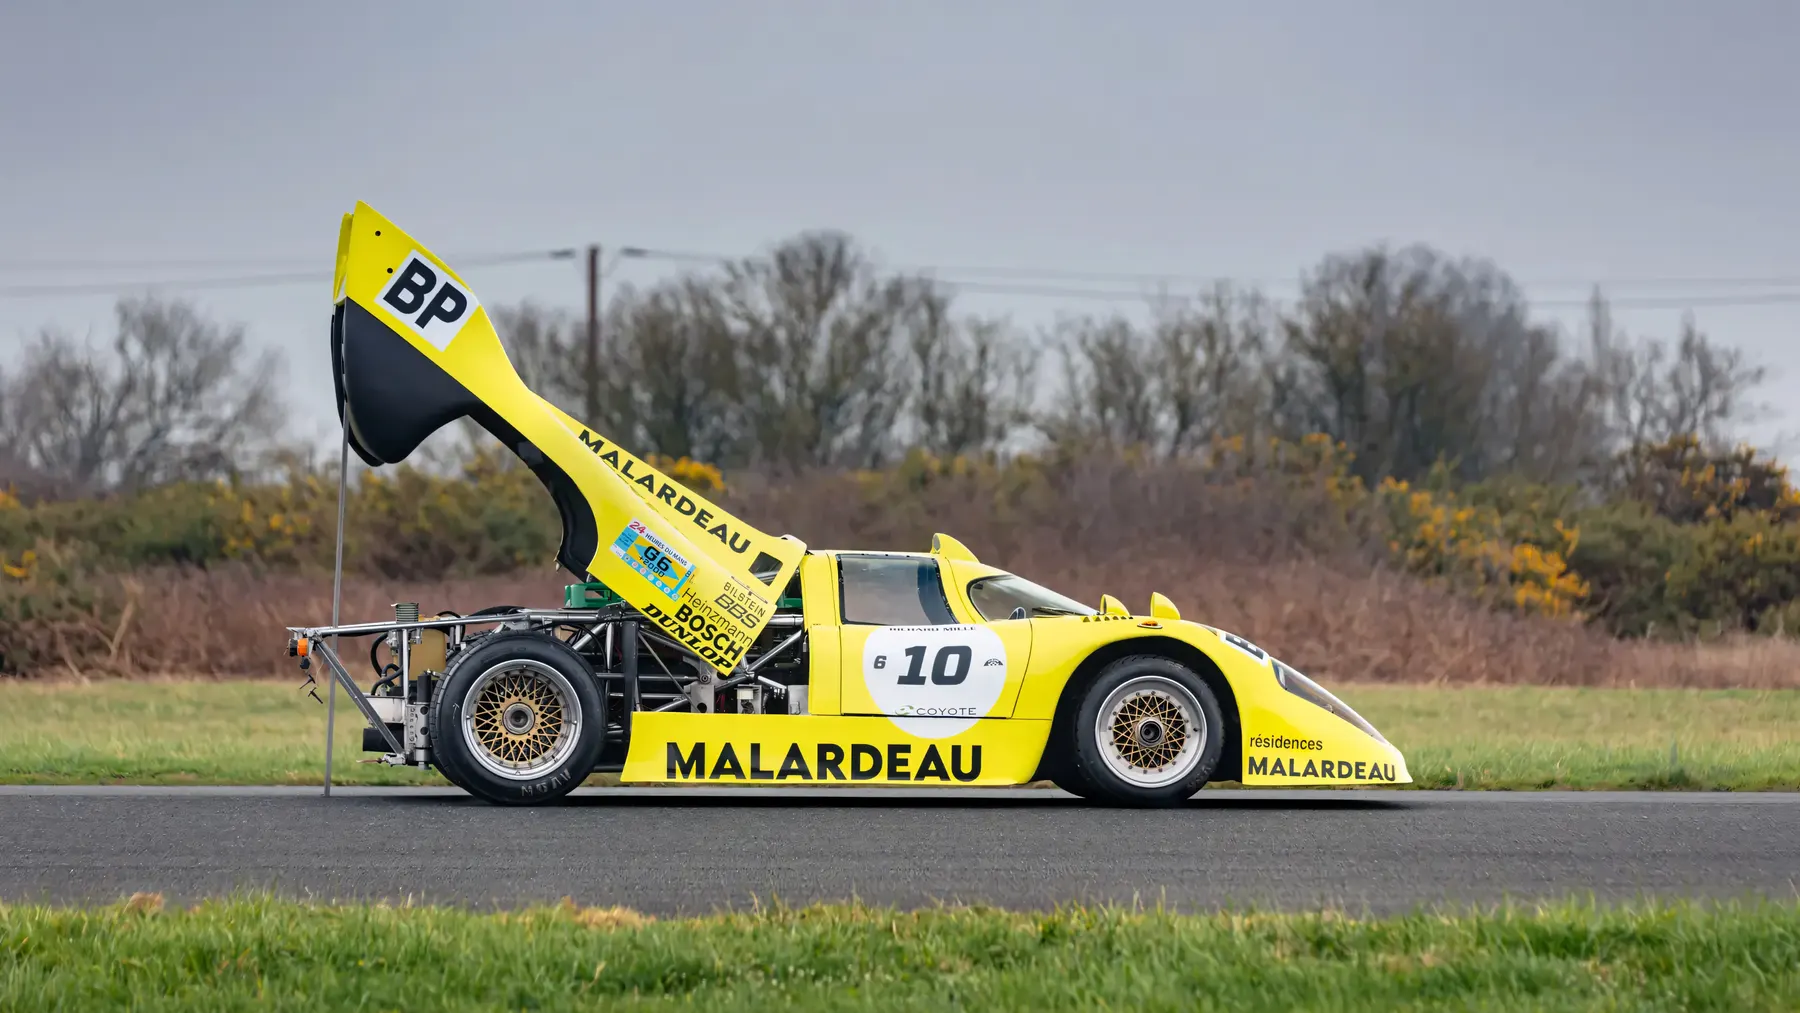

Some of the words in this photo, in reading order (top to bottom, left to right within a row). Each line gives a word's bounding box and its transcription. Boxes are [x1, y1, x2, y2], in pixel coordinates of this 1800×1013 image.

[383, 257, 467, 329] BP
[578, 429, 751, 553] MALARDEAU
[629, 521, 646, 534] 24
[645, 533, 665, 549] HEURES
[664, 547, 673, 555] DU
[672, 553, 688, 566] MANS
[644, 546, 672, 572] G6
[682, 587, 753, 648] Heinzmann
[714, 593, 760, 629] BBS
[723, 582, 766, 617] BILSTEIN
[641, 603, 733, 669] DUNLOP
[674, 604, 744, 661] BOSCH
[873, 655, 887, 669] 6
[897, 645, 972, 686] 10
[916, 707, 977, 716] COYOTE
[666, 742, 982, 782] MALARDEAU
[1249, 734, 1323, 751] résidences
[1248, 756, 1396, 782] MALARDEAU
